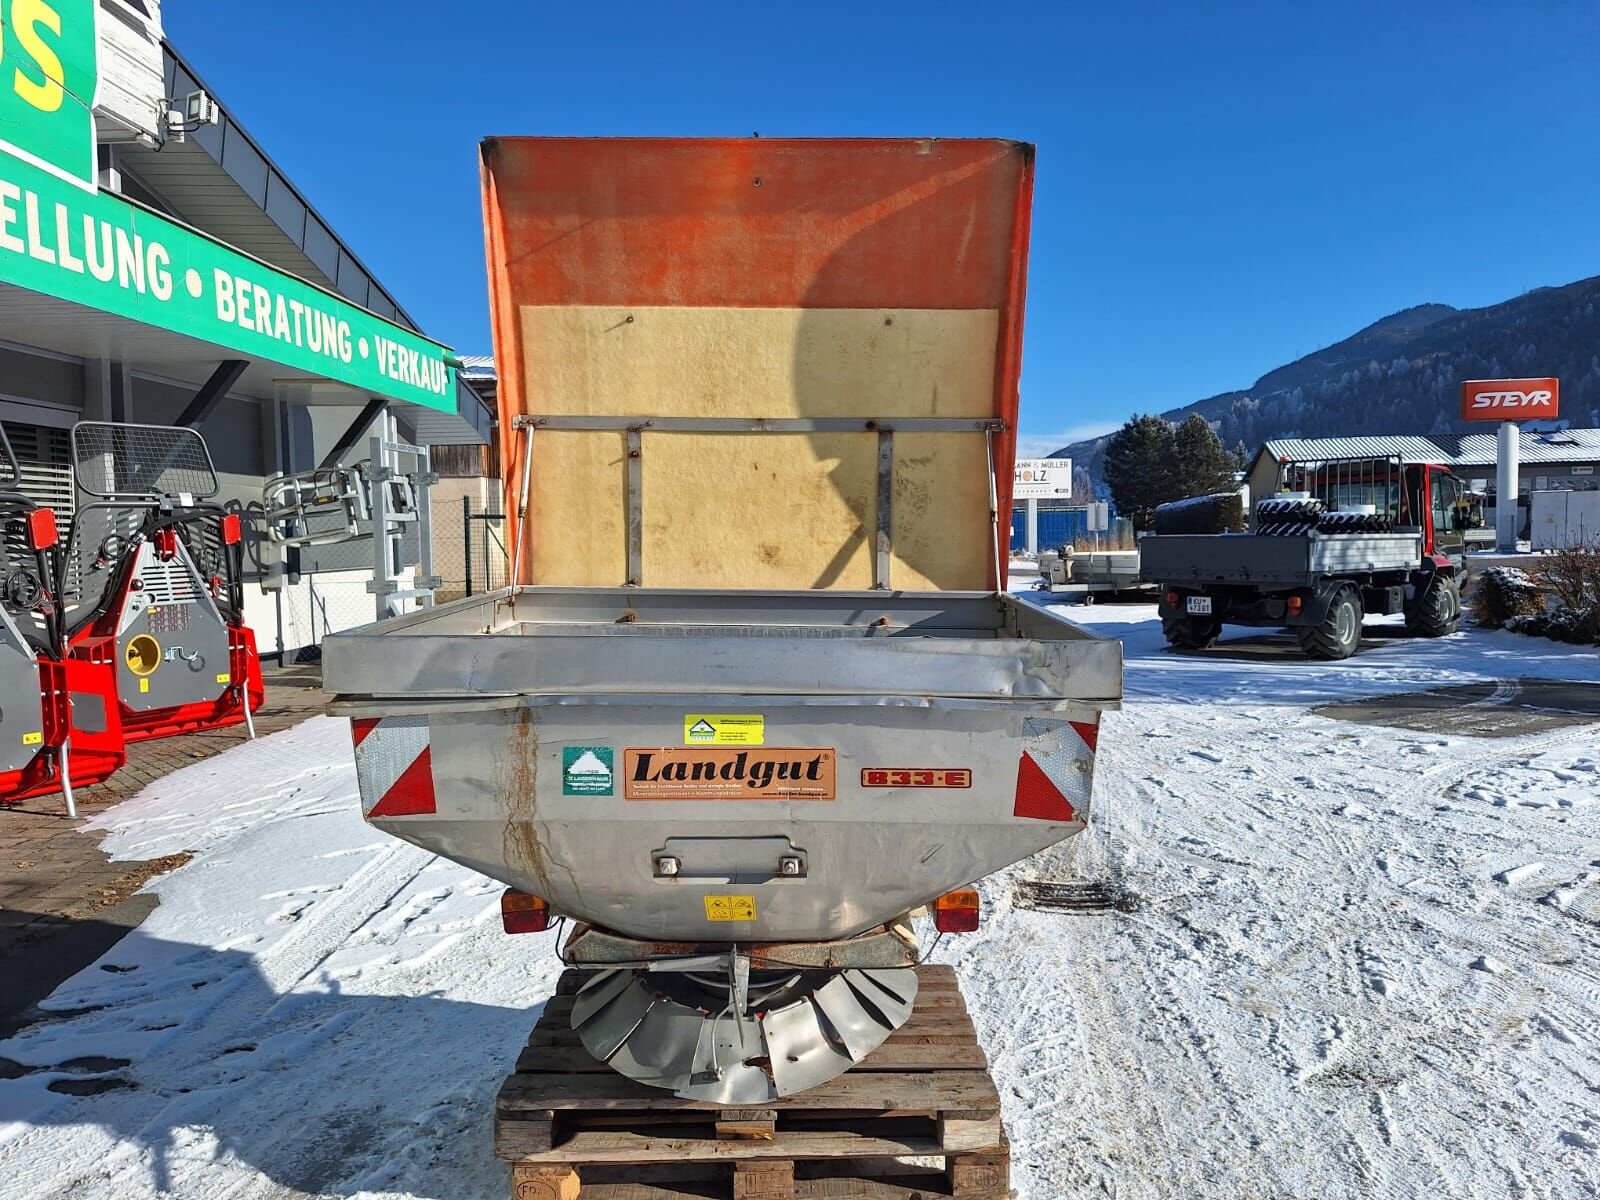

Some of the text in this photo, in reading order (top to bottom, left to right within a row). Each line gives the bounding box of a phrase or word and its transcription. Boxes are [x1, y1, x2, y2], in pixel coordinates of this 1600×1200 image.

[0, 0, 64, 112] S
[0, 179, 173, 301] ELLUNG
[214, 267, 353, 364] BERATUNG
[1471, 390, 1552, 408] STEYR
[1015, 461, 1031, 469] ANN
[1041, 460, 1069, 469] MÜLLER
[1014, 470, 1048, 482] HOLZ
